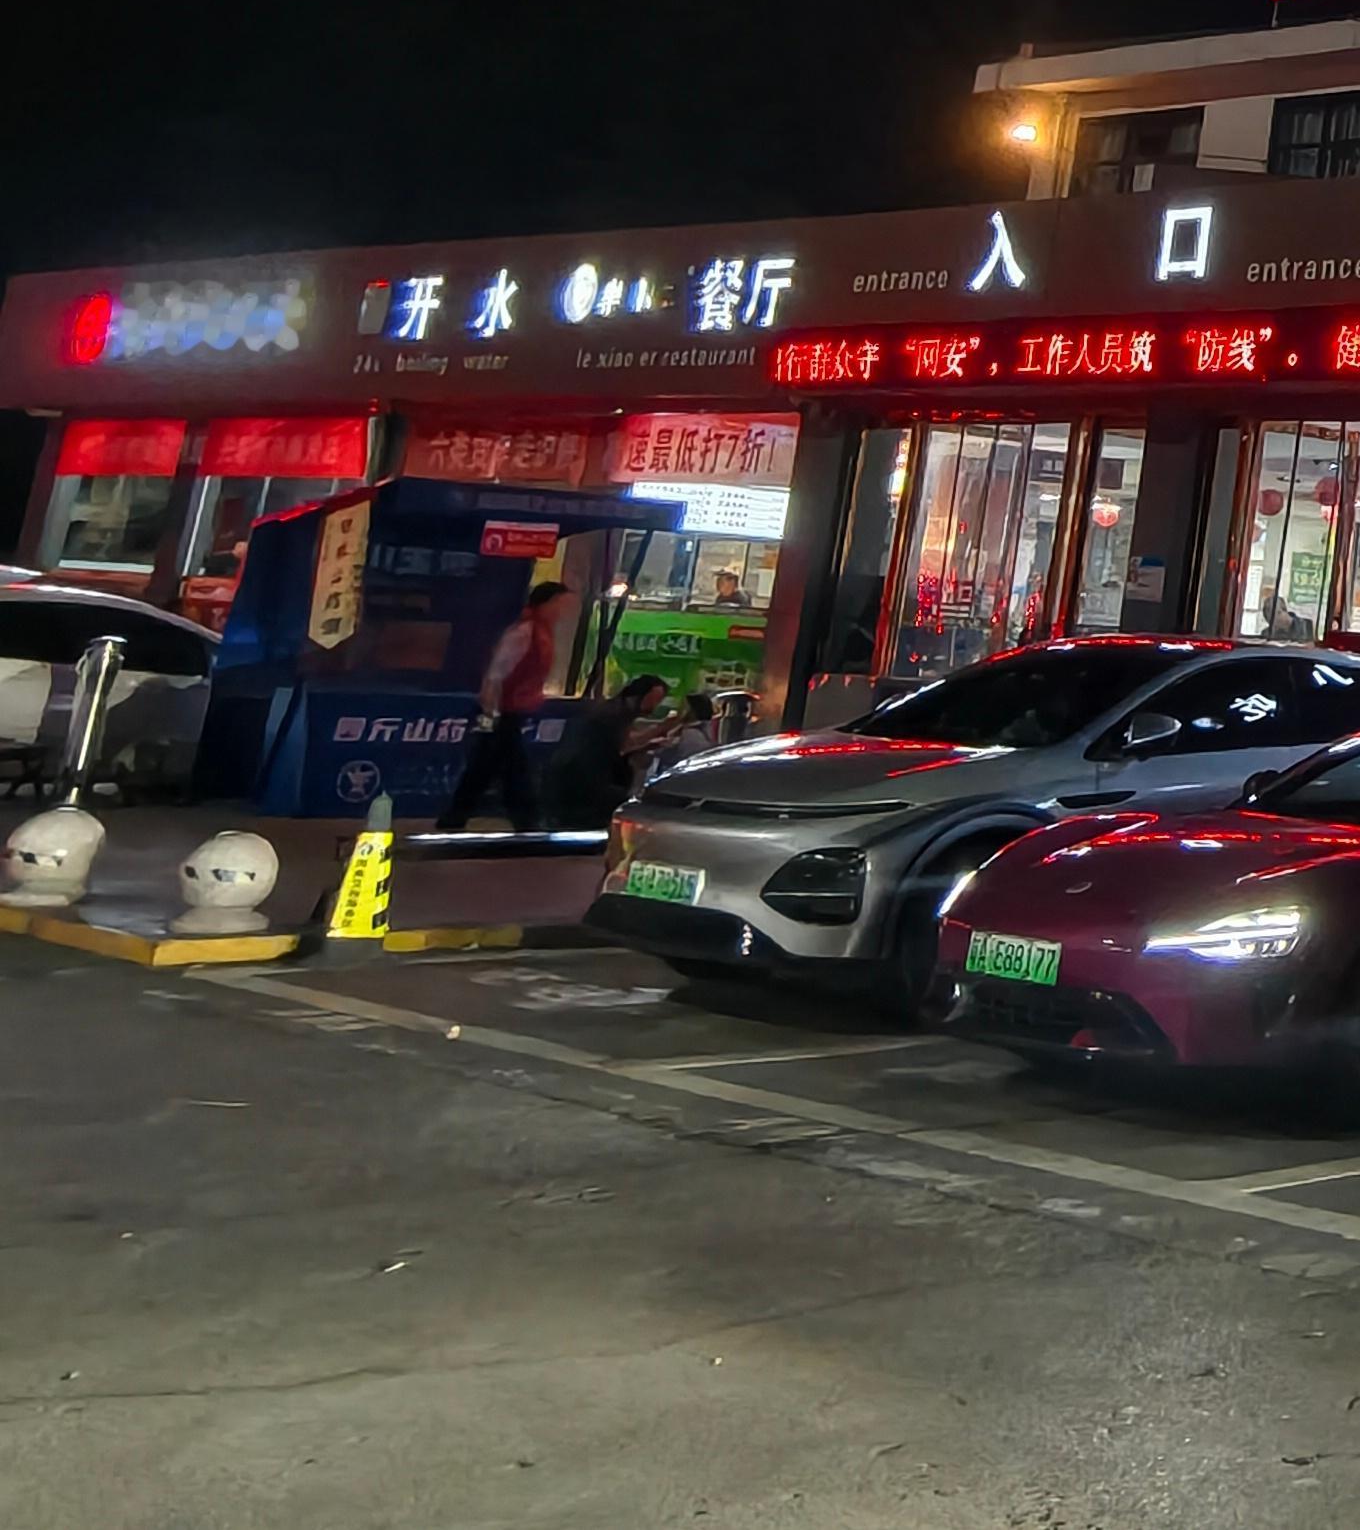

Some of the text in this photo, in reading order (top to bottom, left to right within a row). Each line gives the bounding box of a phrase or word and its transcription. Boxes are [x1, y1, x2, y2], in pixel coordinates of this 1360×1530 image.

[853, 267, 949, 294] entrance
[967, 206, 1214, 291] 入口
[397, 268, 520, 341] 开水
[695, 257, 795, 334] 餐厅
[661, 345, 756, 368] restaurant
